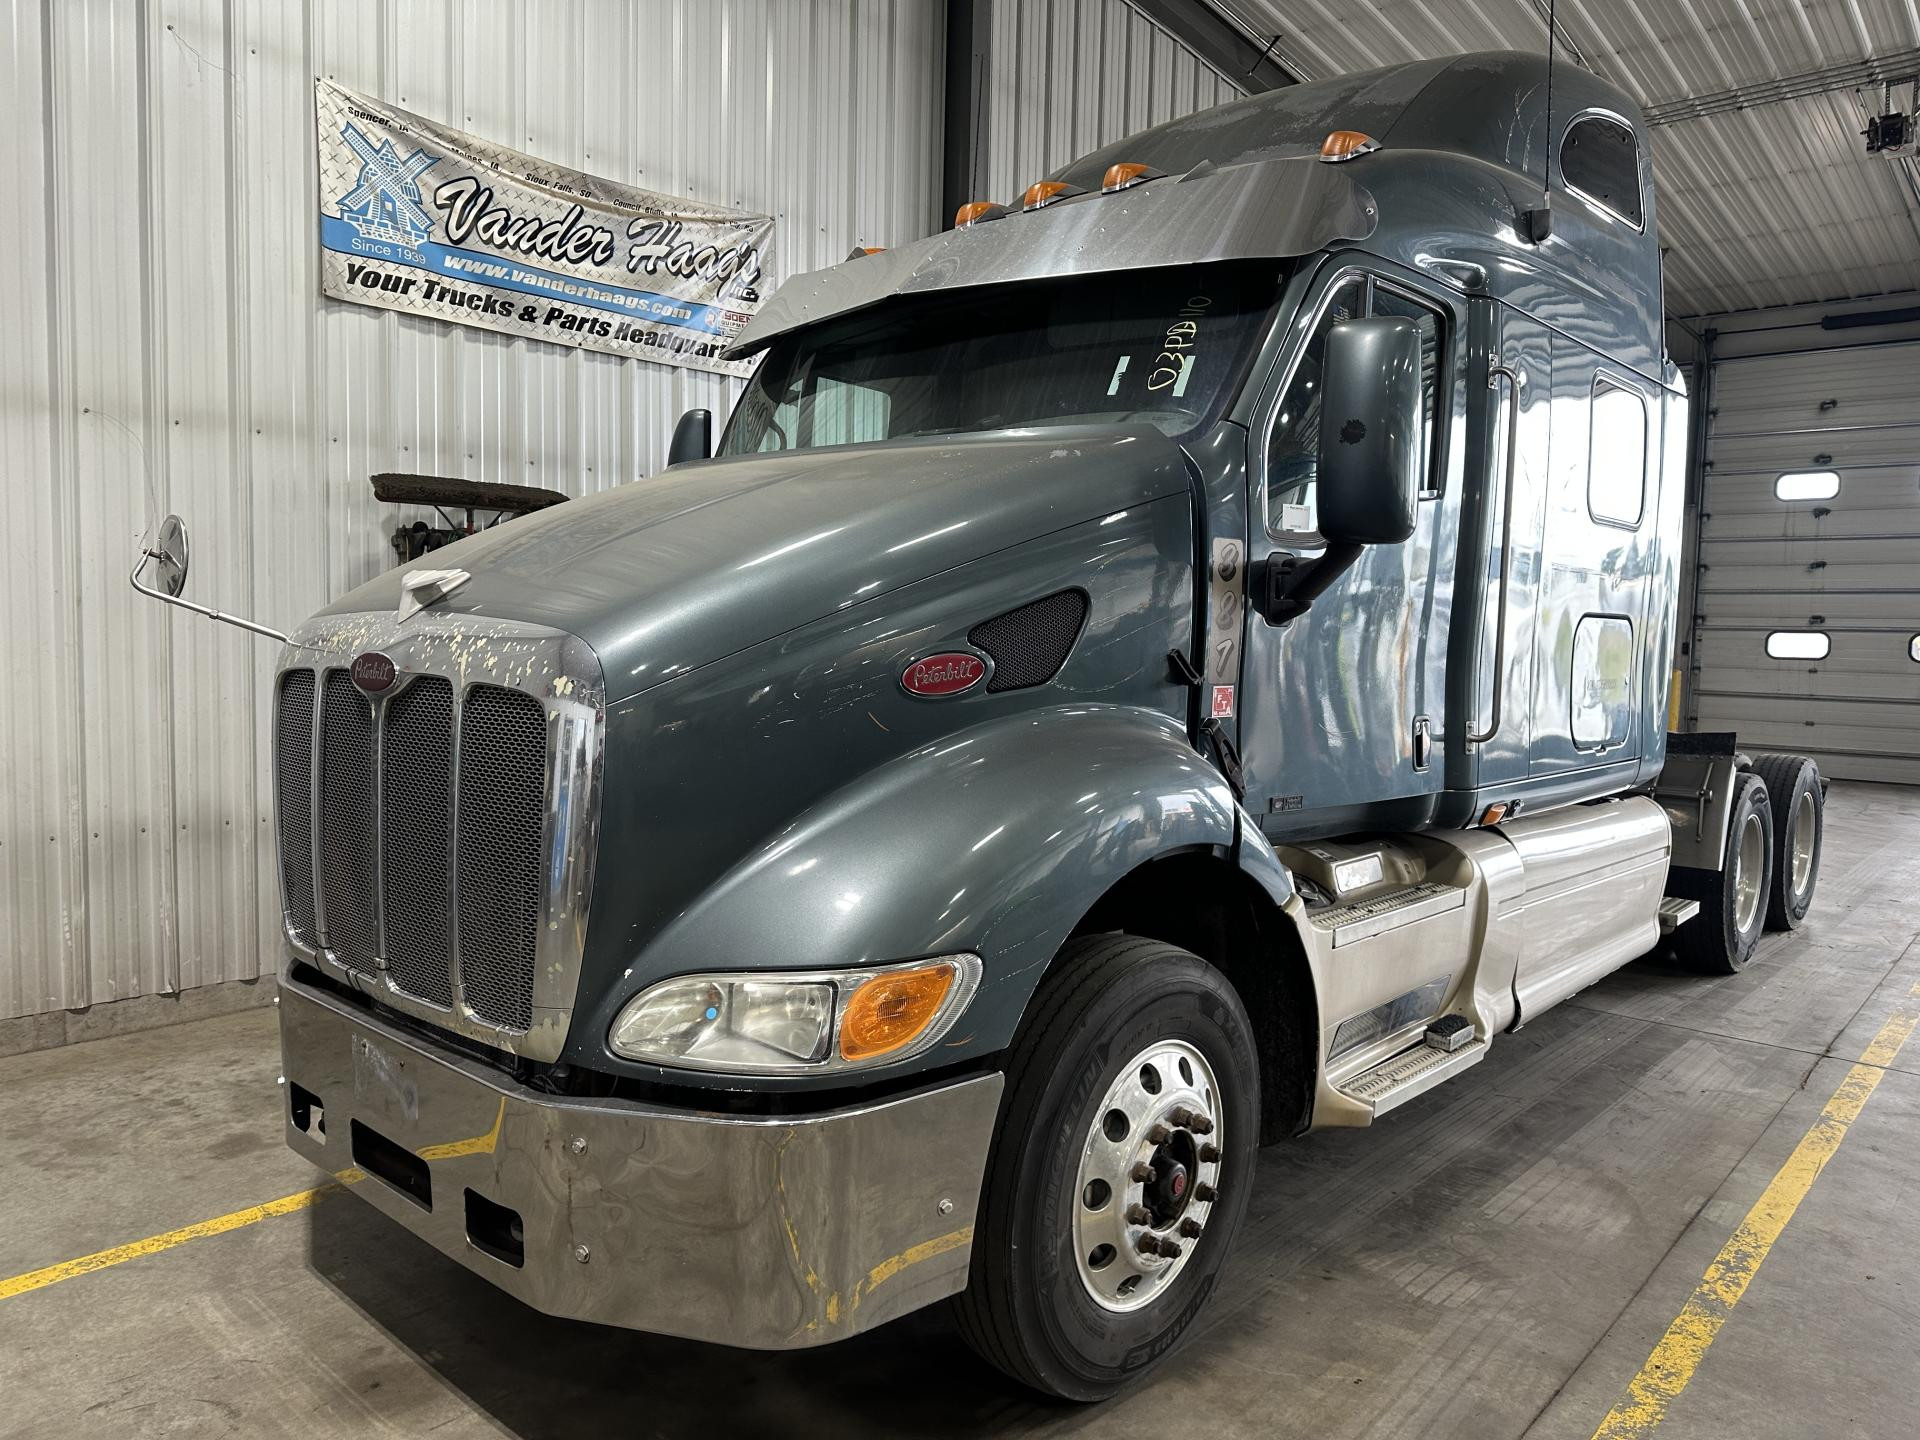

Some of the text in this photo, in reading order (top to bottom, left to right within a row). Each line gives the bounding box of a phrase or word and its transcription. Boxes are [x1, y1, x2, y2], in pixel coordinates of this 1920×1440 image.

[347, 106, 392, 129] Spencer,
[525, 173, 549, 187] Sioux
[579, 189, 592, 199] SD
[613, 199, 641, 211] Council
[351, 238, 426, 265] Since 1939
[433, 176, 760, 302] Vander Haag's
[346, 263, 417, 295] Your
[422, 278, 515, 317] Trucks
[518, 305, 538, 323] &
[543, 307, 612, 337] Parts
[443, 254, 692, 320] www.vanderhaags.com
[353, 658, 392, 681] Peterbilt
[913, 661, 977, 689] Peterbilt
